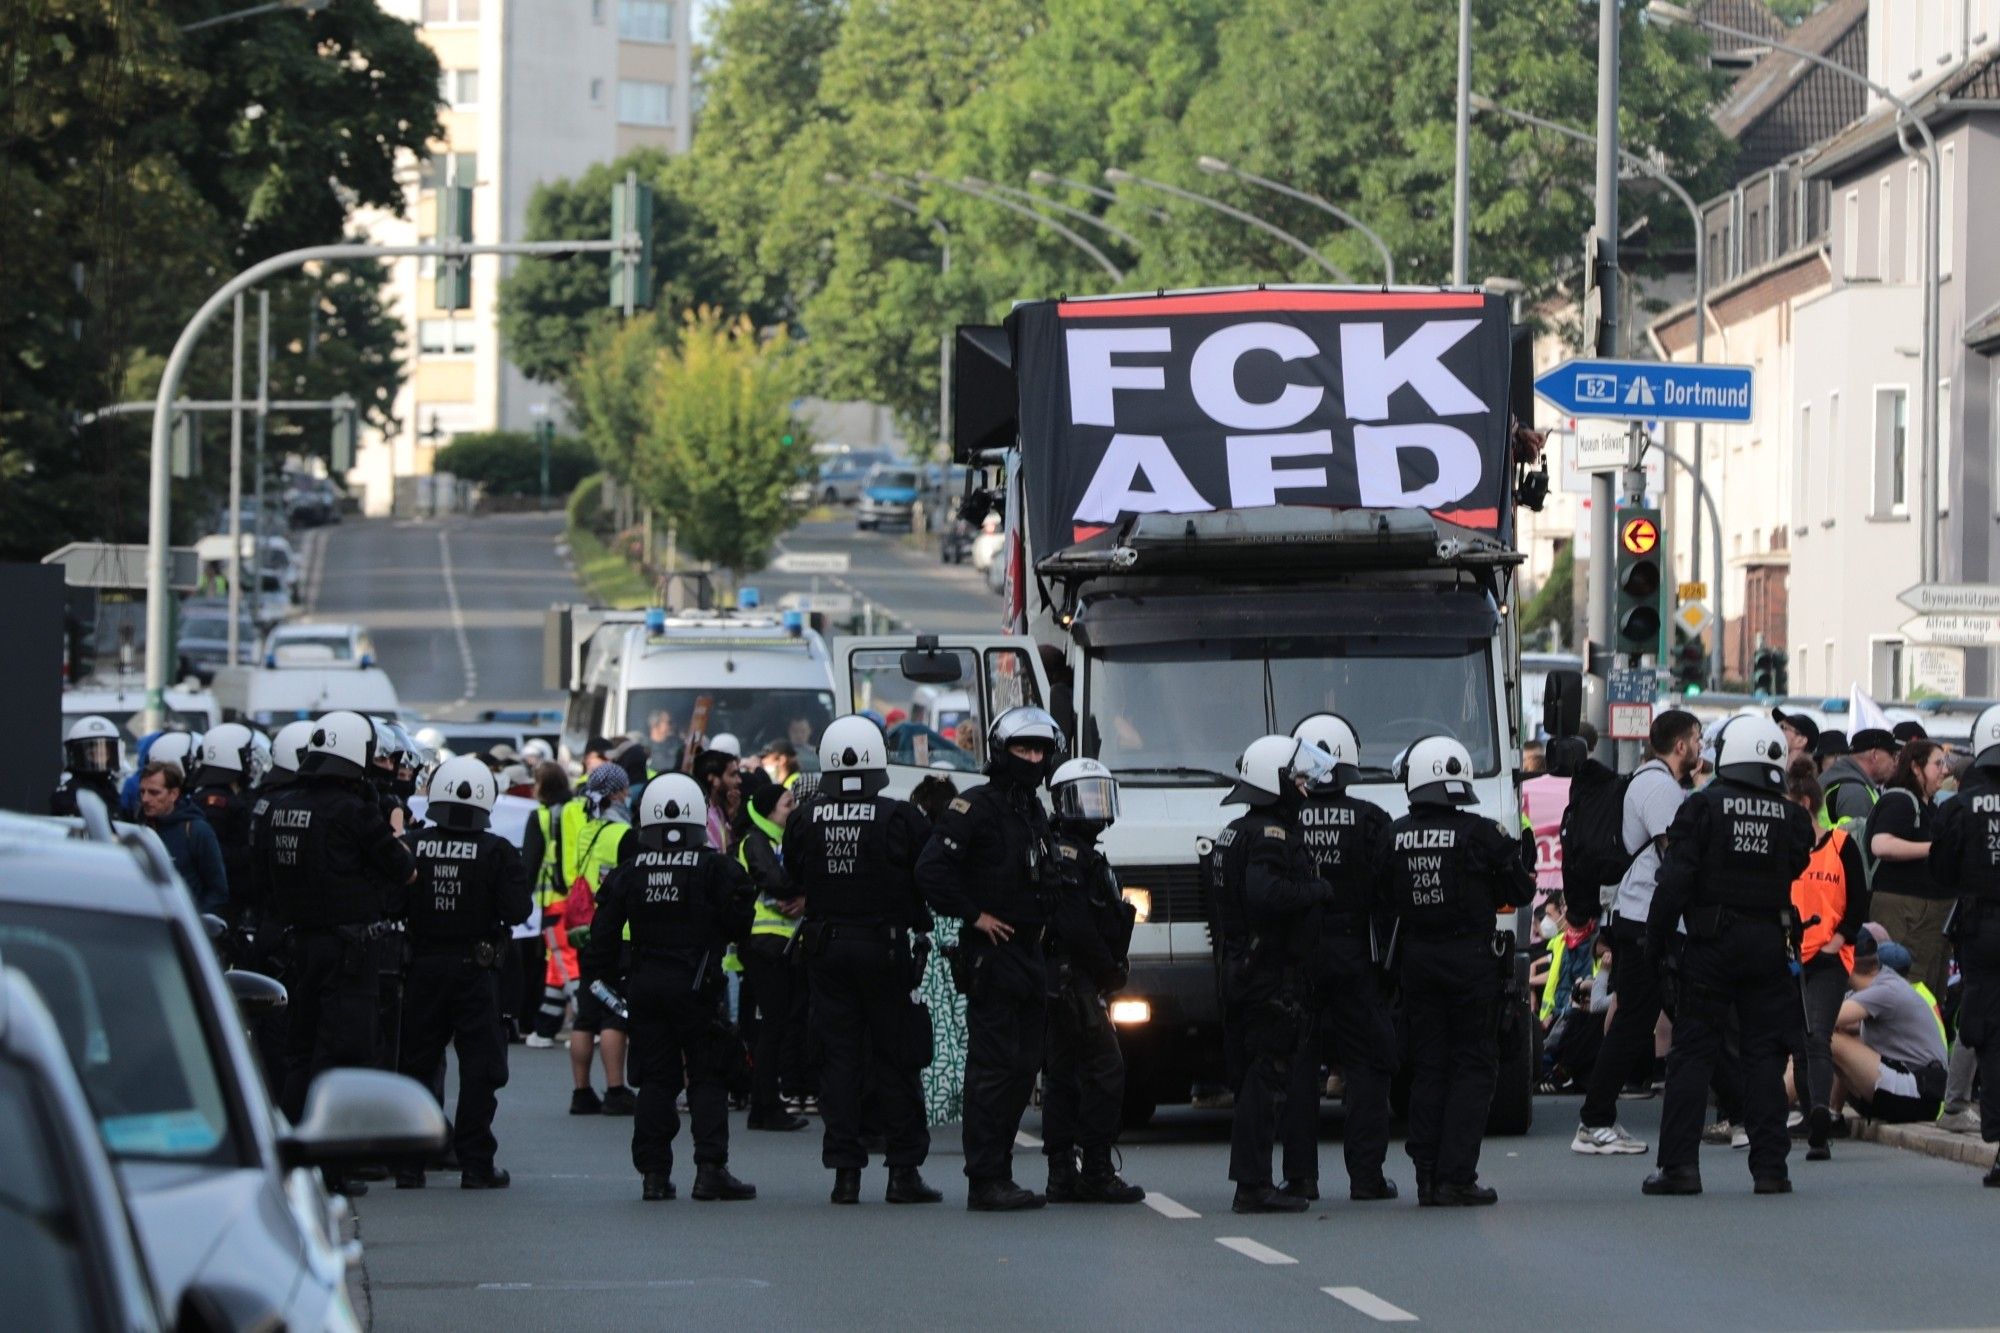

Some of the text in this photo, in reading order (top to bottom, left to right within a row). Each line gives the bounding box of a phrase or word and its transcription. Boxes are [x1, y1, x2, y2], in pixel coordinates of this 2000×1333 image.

[1065, 320, 1490, 430] FCK
[1586, 379, 1748, 408] 52 Dortmund
[1073, 423, 1483, 523] AFD
[1926, 615, 1991, 632] Alfried Krupp
[327, 732, 337, 748] 3
[1755, 739, 1766, 756] 6
[831, 750, 871, 769] 6 4
[1333, 744, 1341, 759] 4
[1242, 761, 1249, 776] 4
[1432, 759, 1470, 777] 6 4
[444, 781, 486, 800] 4 3
[653, 803, 691, 820] 6 4
[812, 803, 876, 823] POLIZEI
[1298, 807, 1356, 827] OLIZEI
[1723, 798, 1786, 819] POLIZEI
[271, 809, 312, 829] POLIZEI
[824, 826, 861, 842] NRW
[1303, 830, 1340, 846] NRW
[1733, 821, 1769, 838] NRW
[275, 835, 299, 849] NRW
[1394, 829, 1456, 851] POLIZEI
[1734, 837, 1769, 854] 2642
[415, 840, 478, 860] POLIZEI
[825, 843, 858, 858] 2641
[1310, 850, 1341, 865] 642
[635, 851, 700, 867] POLIZEI
[827, 859, 856, 874] BAT
[1408, 856, 1442, 872] NRW
[434, 864, 459, 879] NRW
[647, 872, 673, 887] NRW
[1412, 872, 1441, 888] 264
[1808, 871, 1841, 886] TEAM
[432, 880, 462, 895] 1431
[645, 886, 680, 903] 2642
[435, 896, 456, 911] RH
[1412, 888, 1444, 906] BeSi
